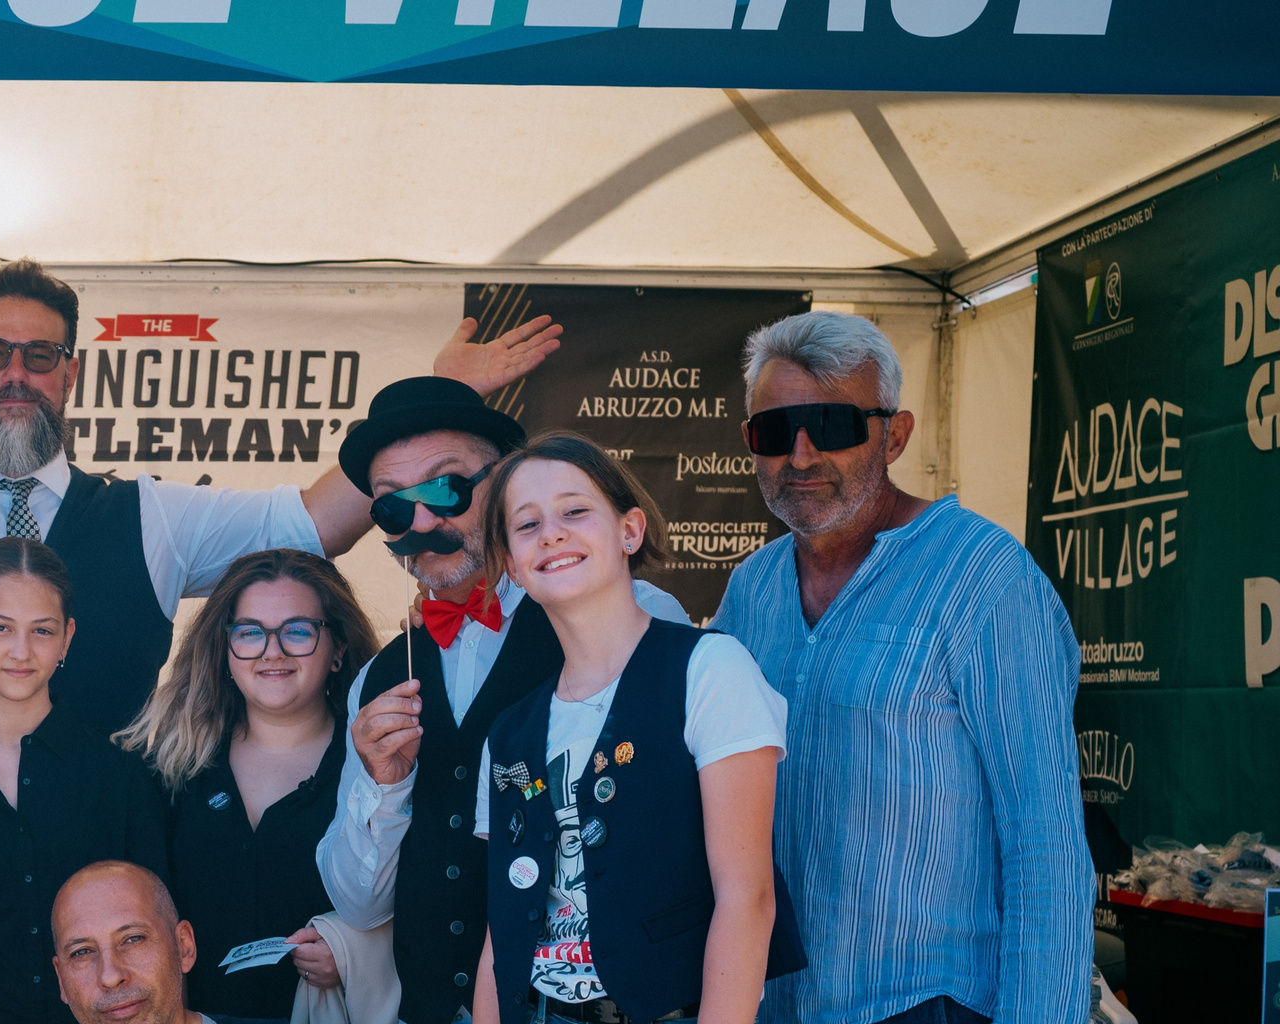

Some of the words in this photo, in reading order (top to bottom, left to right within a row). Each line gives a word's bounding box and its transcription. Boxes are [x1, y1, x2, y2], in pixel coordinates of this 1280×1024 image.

[1061, 240, 1076, 257] CON
[1086, 210, 1144, 246] PARTECIPAZIONE
[141, 318, 172, 333] THE
[639, 350, 673, 363] A.S.D.
[608, 367, 701, 389] AUDACE
[576, 397, 682, 418] ABRUZZO
[687, 398, 728, 418] M.F.
[1052, 397, 1183, 503] AUDACE
[667, 522, 768, 534] MOTOCICLETTE
[669, 535, 766, 561] TRIUMPH
[1055, 508, 1178, 589] VILLAGE
[1079, 636, 1144, 664] toabruzzo
[1128, 667, 1160, 682] Motorrad
